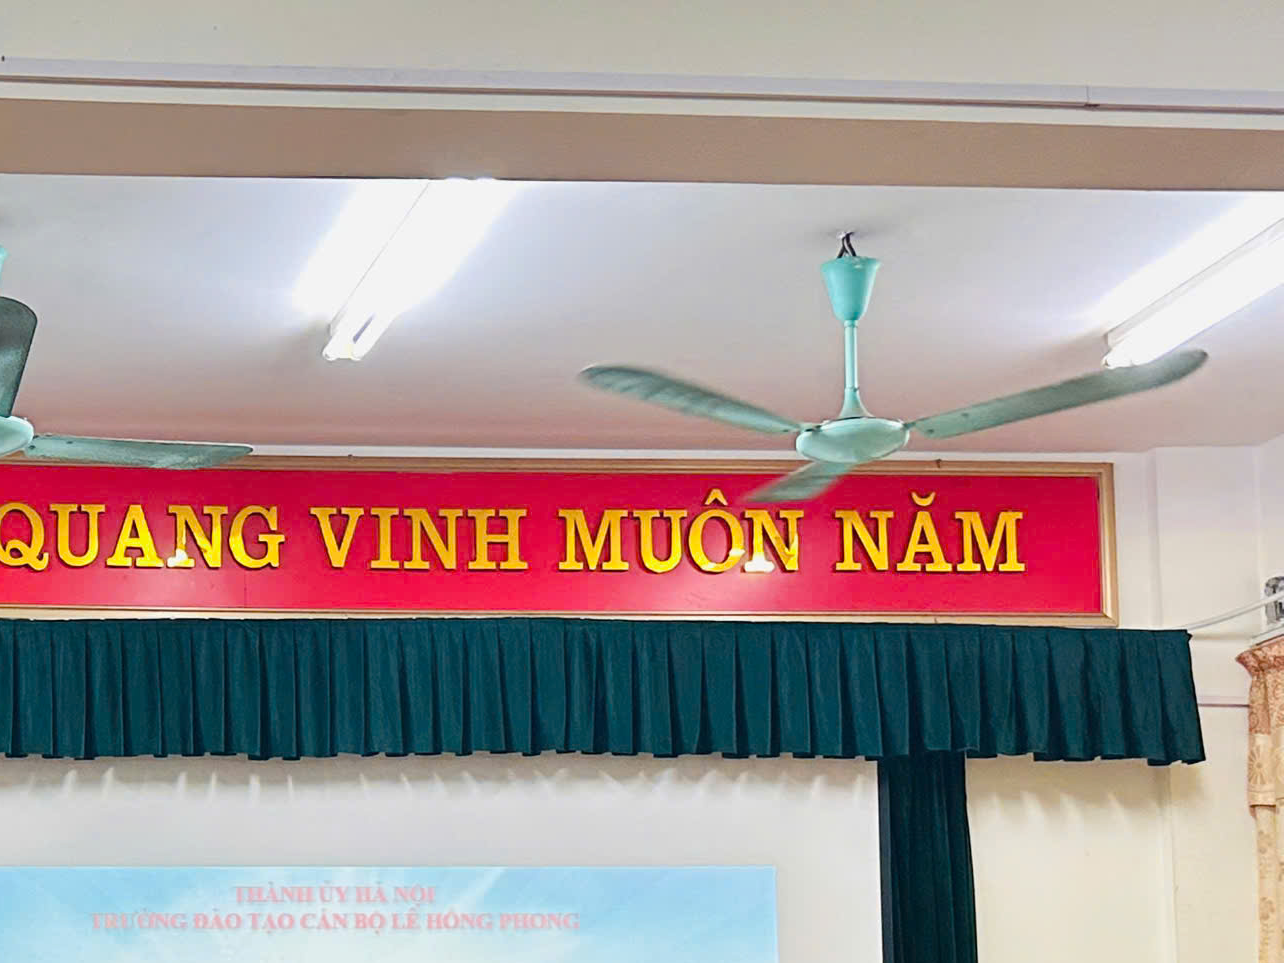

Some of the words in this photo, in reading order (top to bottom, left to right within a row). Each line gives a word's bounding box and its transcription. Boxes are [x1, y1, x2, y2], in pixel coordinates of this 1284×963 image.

[310, 506, 528, 572] VINH
[558, 488, 806, 574] MUÔN
[834, 491, 1026, 573] NĂM
[235, 881, 315, 904] THÀNH
[355, 881, 388, 904] HÀ
[394, 884, 436, 907] NỘI
[193, 908, 242, 931] ĐÀO
[247, 912, 296, 934] TẠO
[354, 910, 387, 936] BỘ
[499, 912, 580, 931] PHONG
